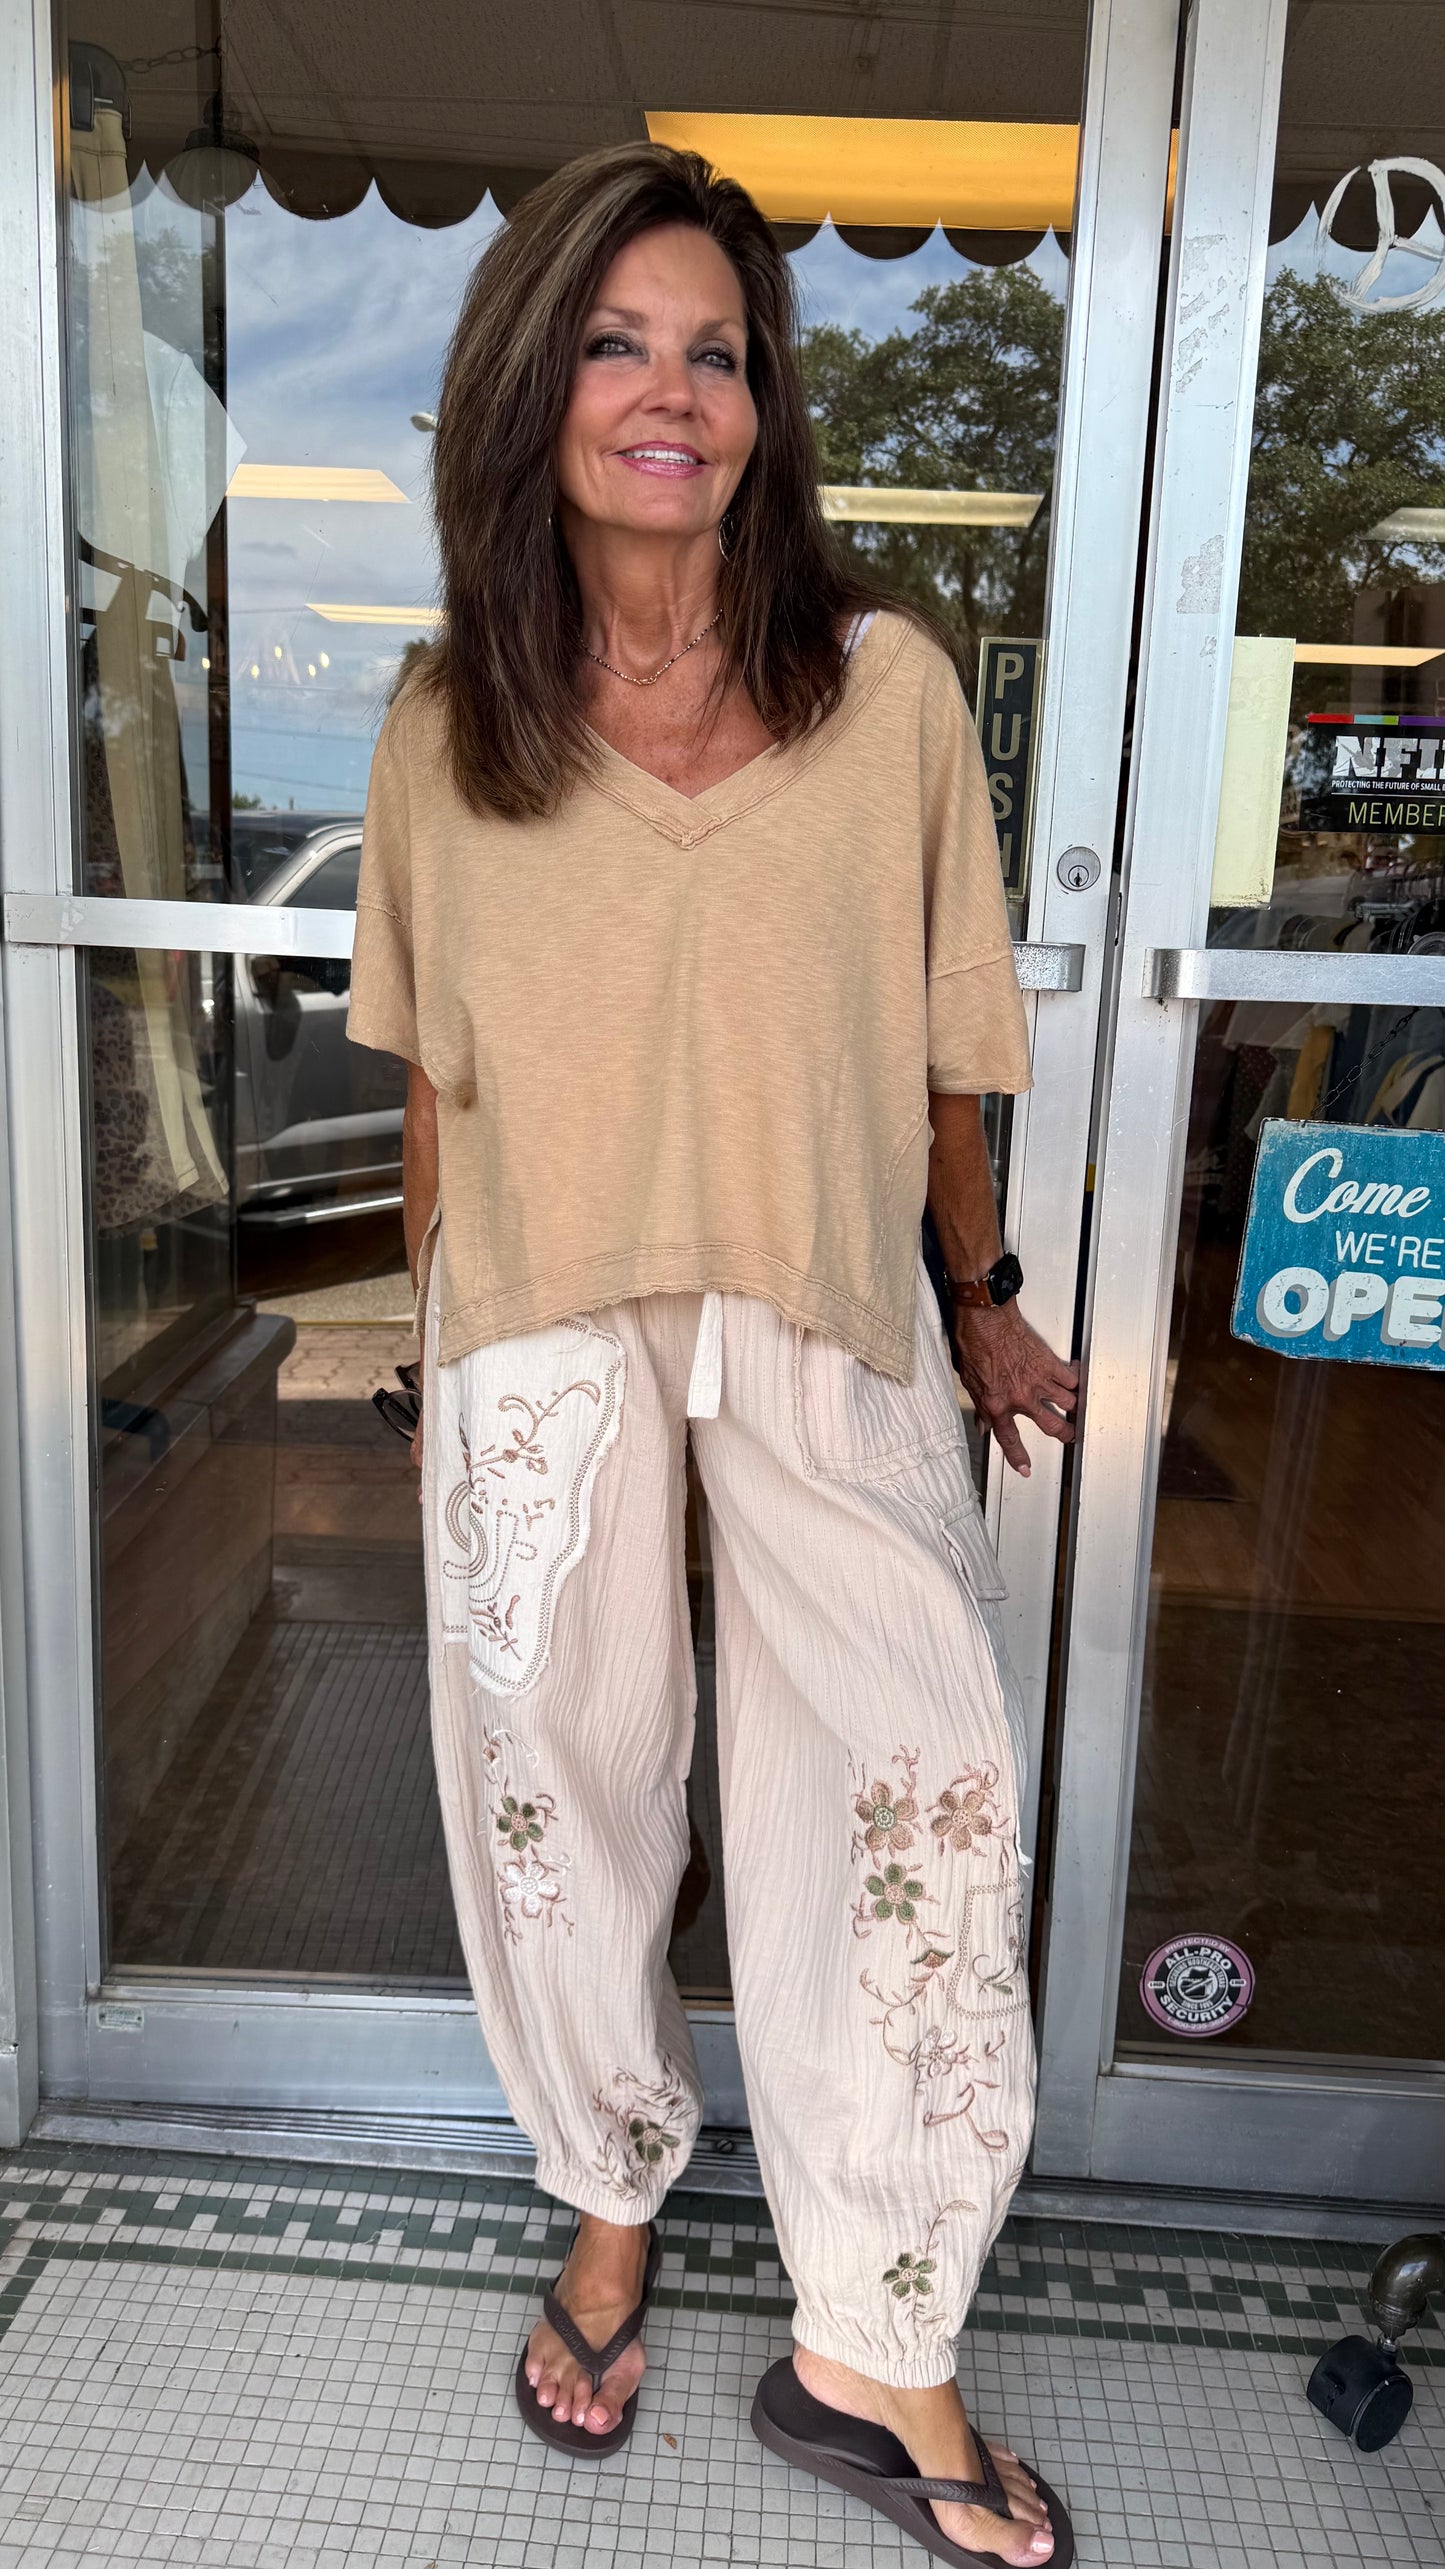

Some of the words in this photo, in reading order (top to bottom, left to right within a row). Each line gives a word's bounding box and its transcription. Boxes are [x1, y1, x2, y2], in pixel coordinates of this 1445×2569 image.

[1332, 735, 1445, 780] NFI
[1331, 780, 1371, 789] PROTECTING
[1372, 781, 1384, 789] THE
[1384, 781, 1410, 790] FUTURE
[1410, 782, 1421, 790] OF
[1421, 783, 1441, 791] SMALL
[1283, 1147, 1431, 1224] Come
[1335, 1230, 1445, 1269] WE'RE
[1257, 1266, 1445, 1346] OPE
[1165, 1937, 1218, 1953] PROTECTED
[1218, 1943, 1231, 1953] BY
[1165, 1946, 1232, 1970] ALL-PRO
[1160, 1994, 1233, 2022] SECURITY
